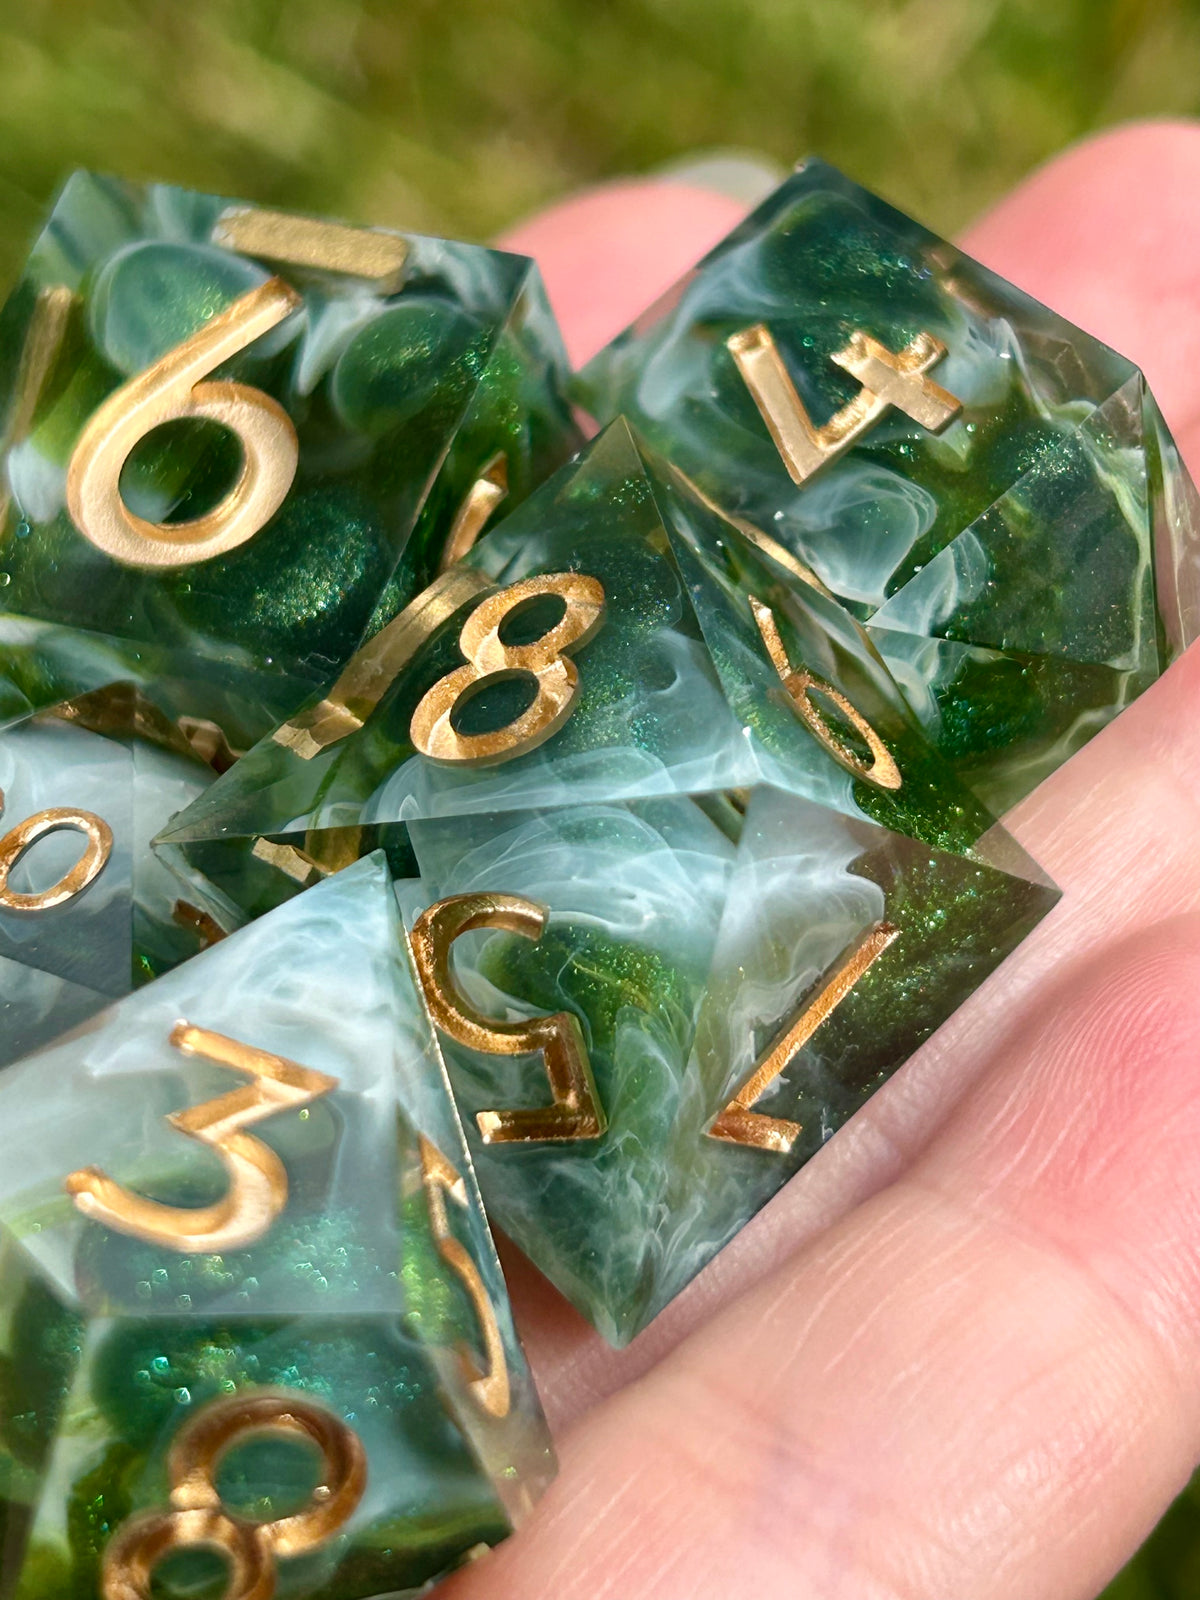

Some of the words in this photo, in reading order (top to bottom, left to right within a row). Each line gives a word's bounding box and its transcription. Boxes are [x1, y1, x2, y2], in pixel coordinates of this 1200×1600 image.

[66, 276, 299, 567] 6
[726, 322, 964, 486] 4
[409, 571, 606, 768] 8
[748, 595, 902, 790] 6
[410, 891, 608, 1144] 5
[703, 920, 900, 1153] 7
[65, 1019, 339, 1254] 3
[103, 1387, 367, 1600] 8
